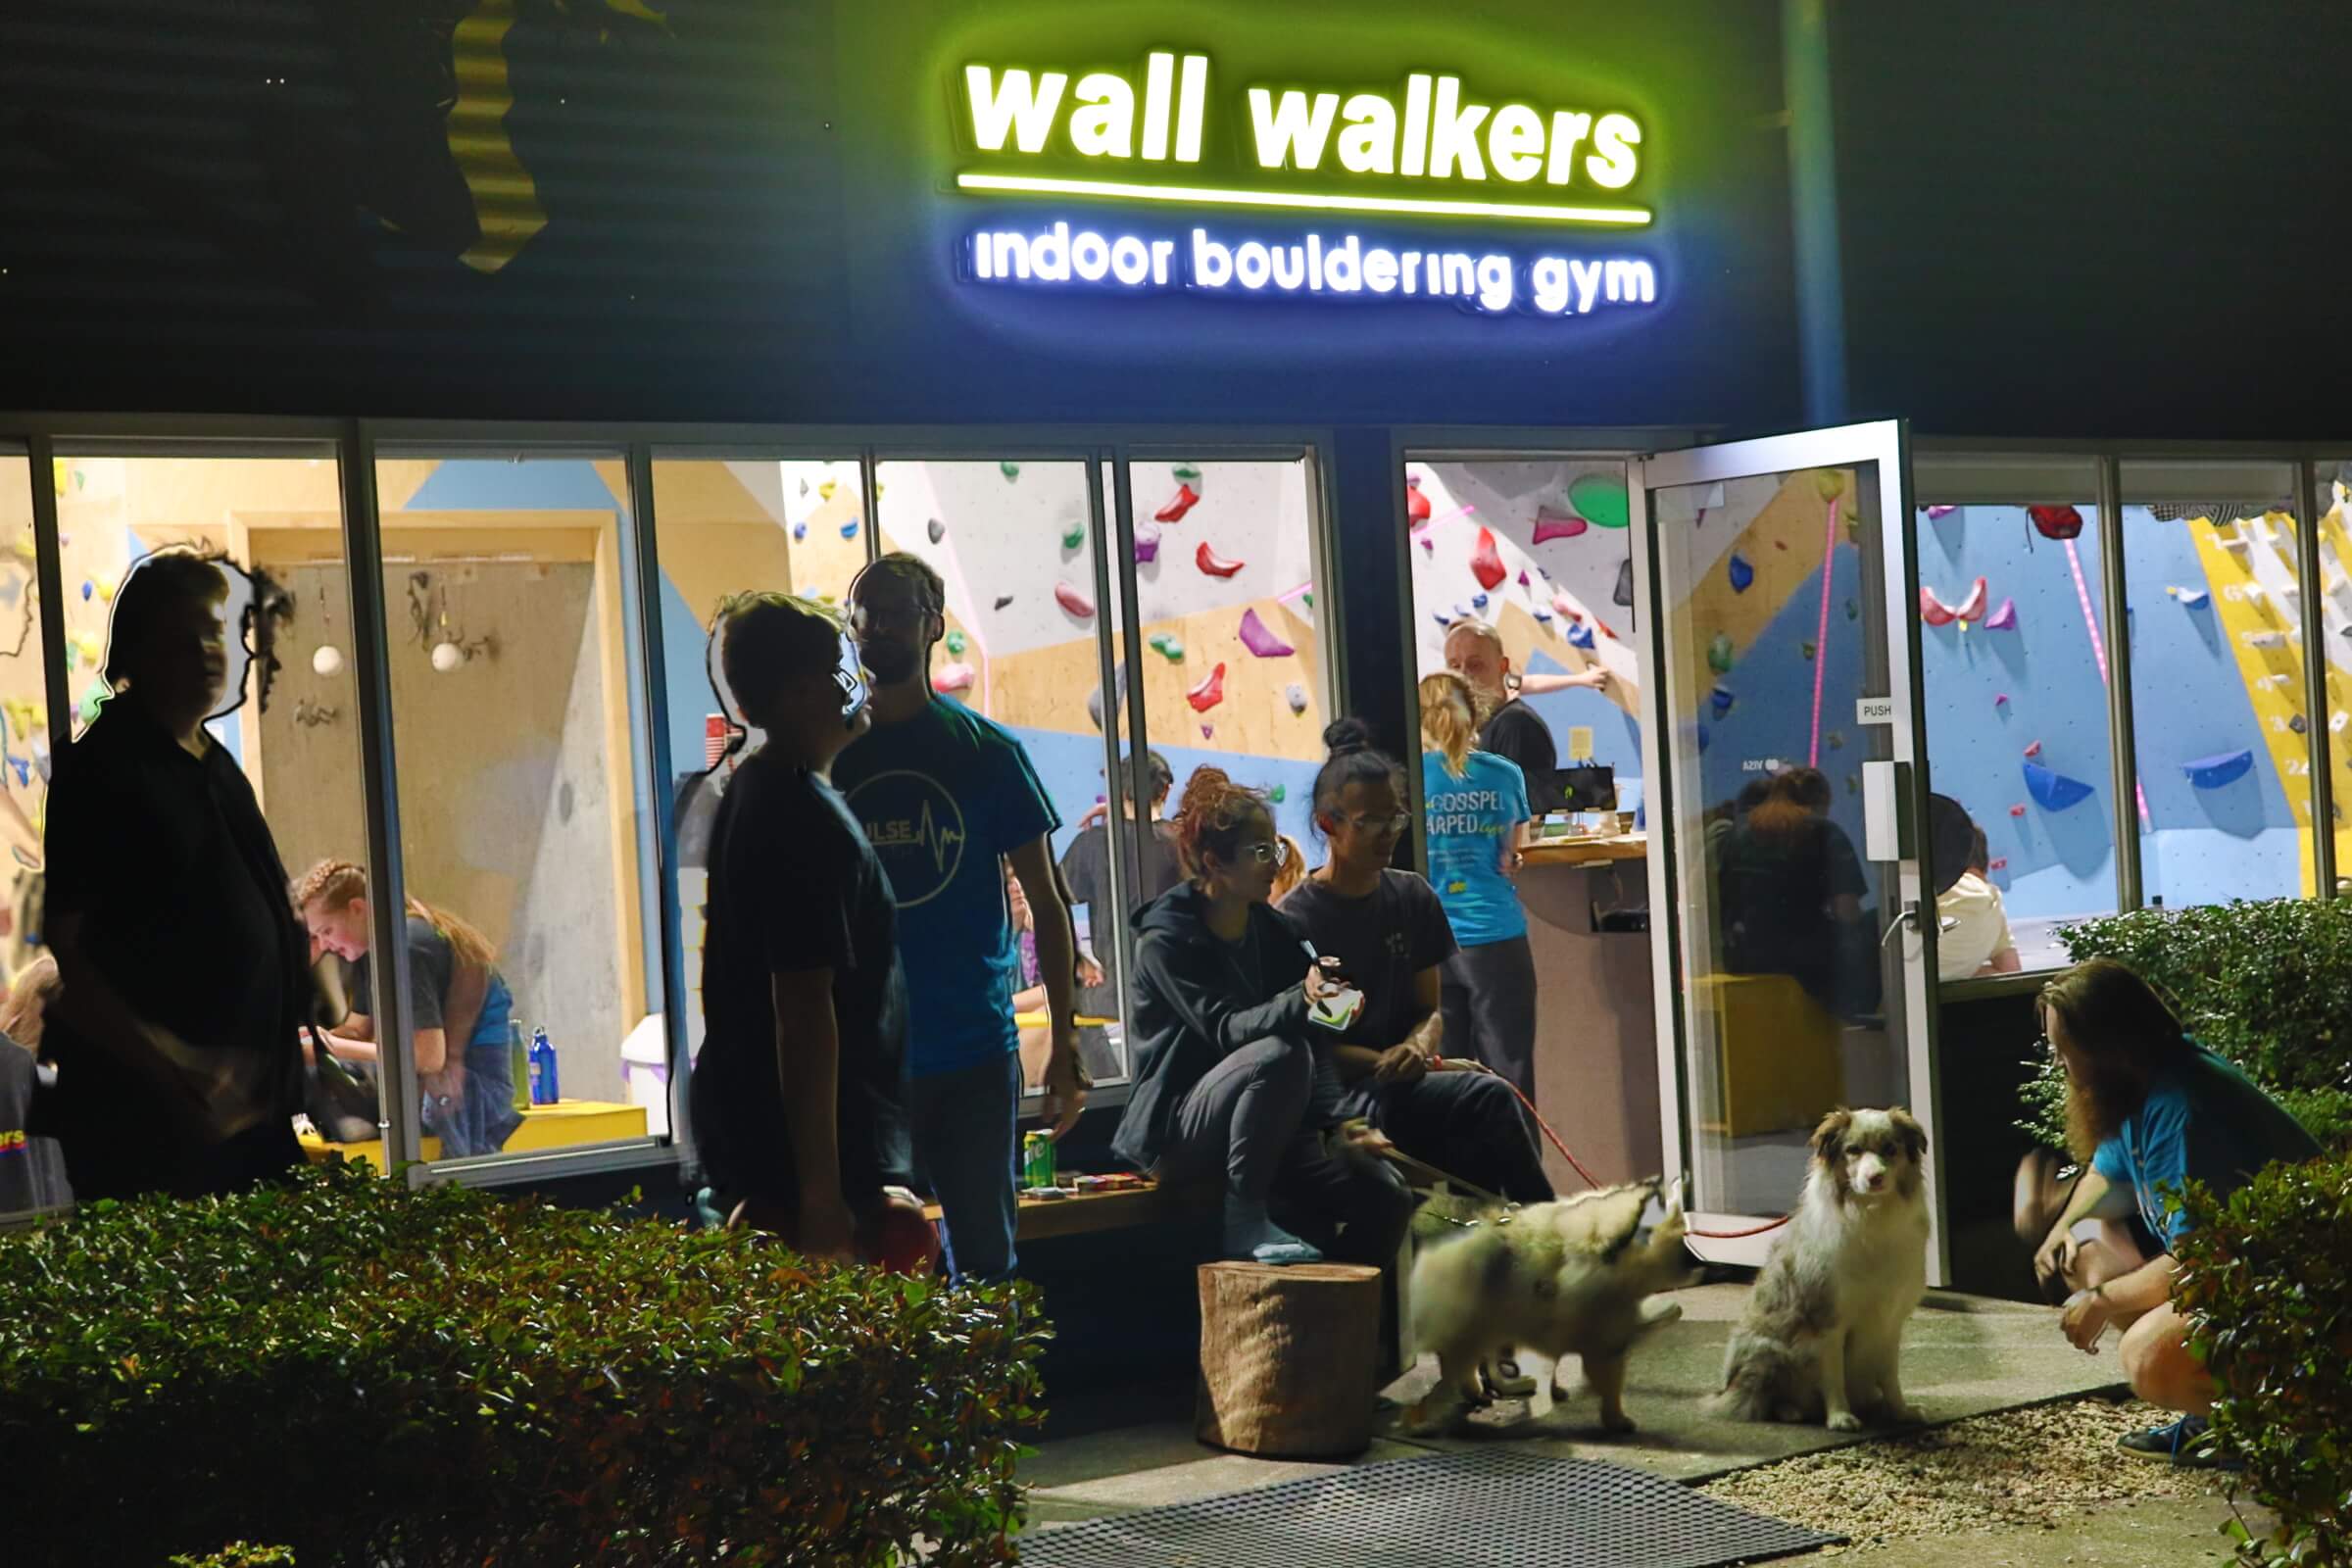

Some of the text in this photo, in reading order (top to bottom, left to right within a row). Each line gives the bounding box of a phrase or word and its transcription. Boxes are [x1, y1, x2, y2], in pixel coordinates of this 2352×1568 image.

[965, 53, 1642, 189] wall walkers
[976, 221, 1655, 314] indoor bouldering gym
[1864, 706, 1891, 716] PUSH
